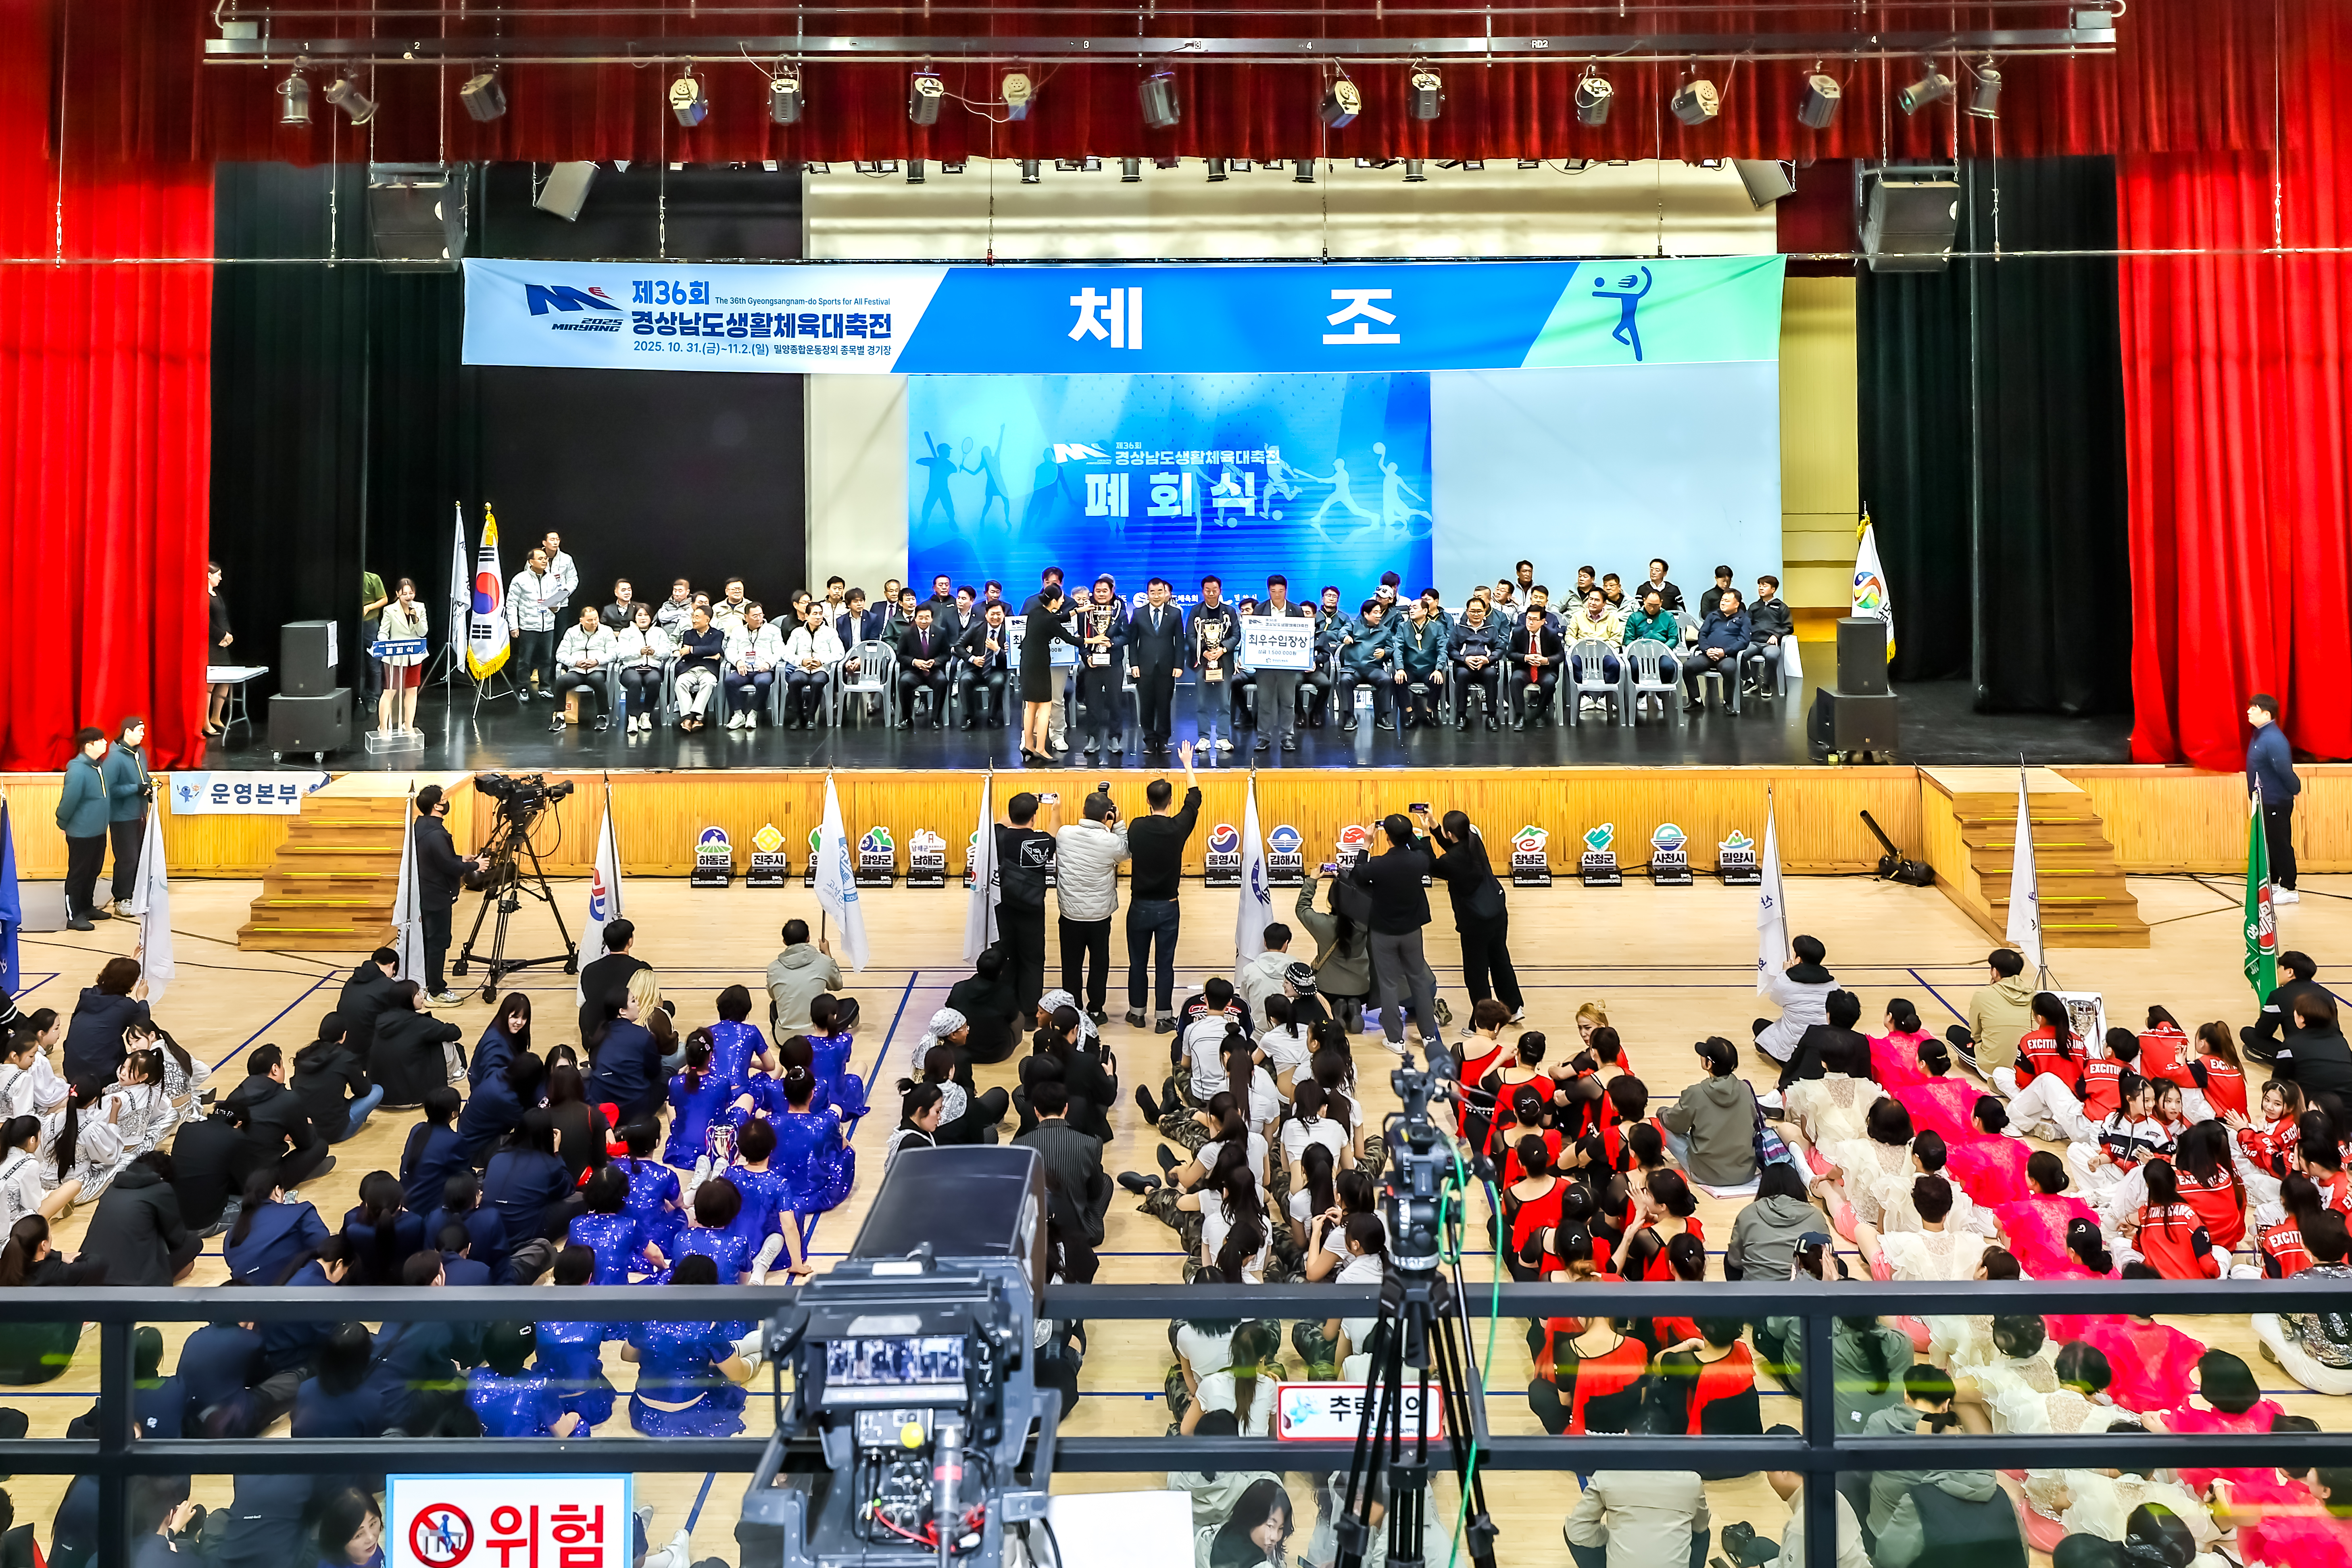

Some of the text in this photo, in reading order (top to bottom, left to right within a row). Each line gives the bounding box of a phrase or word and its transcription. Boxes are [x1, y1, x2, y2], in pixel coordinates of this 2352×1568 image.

[304, 42, 309, 50] 1
[414, 42, 420, 50] 2
[1306, 42, 1312, 50] 4
[632, 280, 709, 305] 제36회
[748, 297, 817, 306] Gyeongsangnam-do
[1067, 287, 1401, 350] 체 조
[551, 323, 621, 332] MIRYANG
[632, 311, 891, 338] 경상남도생활체육대축전
[634, 341, 891, 357] 2025. 10. 31.(금)~11.2.(일) 밀양종합운동장외 종목별 경기장
[1116, 442, 1142, 450] 제36회
[1115, 450, 1280, 466] 경상남도생활체육대축전
[1084, 471, 1255, 517] 폐 회 식
[1249, 634, 1308, 648] 최우수입장상
[211, 783, 298, 805] 운영본부
[699, 855, 729, 865] 하동군
[754, 855, 784, 865] 진주시
[862, 855, 891, 865] 함양군
[913, 855, 942, 865] 남해군
[1208, 855, 1239, 865] 통영시
[1270, 855, 1300, 865] 김해시
[1339, 855, 1356, 865] 거제
[1515, 854, 1545, 864] 창녕군
[1584, 854, 1614, 864] 산청군
[1655, 853, 1685, 863] 사천시
[1722, 853, 1754, 863] 밀양시
[1330, 1395, 1422, 1422] 추락의
[486, 1505, 604, 1568] 위험
